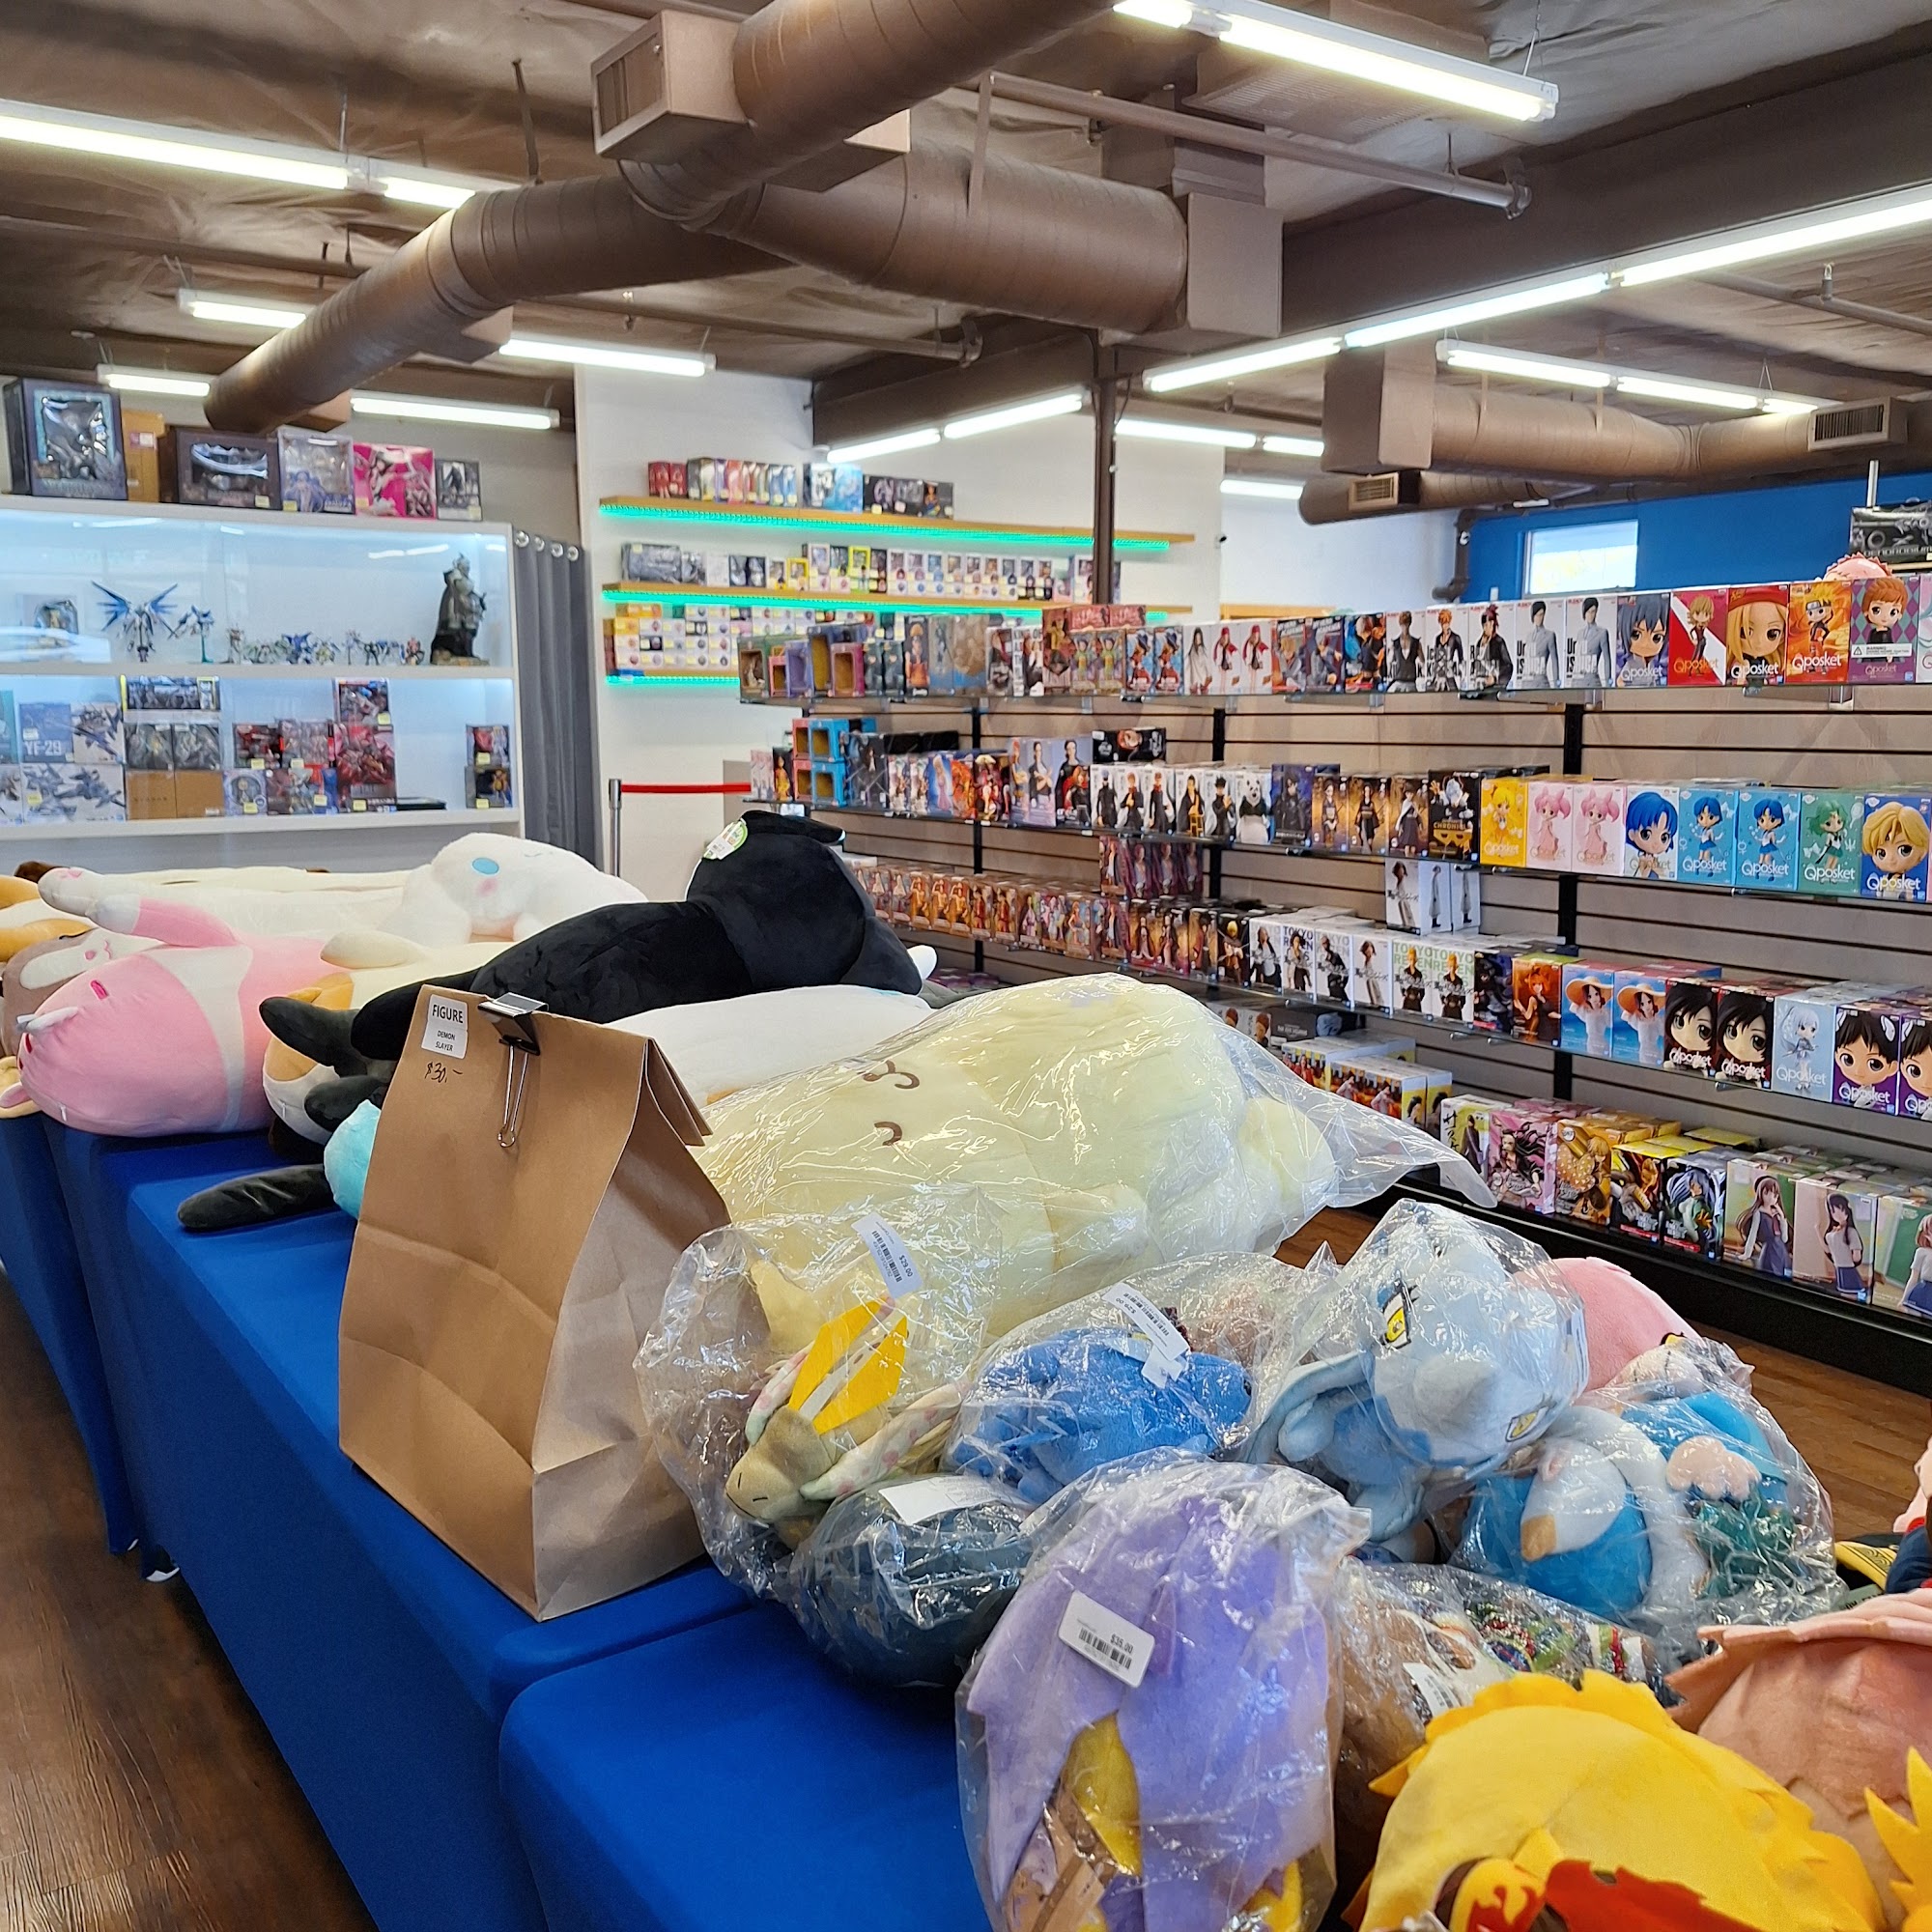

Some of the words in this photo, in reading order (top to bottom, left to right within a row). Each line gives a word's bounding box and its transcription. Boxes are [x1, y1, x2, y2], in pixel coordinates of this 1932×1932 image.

[1730, 659, 1779, 679] Qposket
[1792, 651, 1842, 669] Qposket
[1621, 665, 1663, 682] Qposket
[1864, 664, 1898, 675] Qposket
[1682, 856, 1727, 873] Qposket
[1741, 860, 1790, 877] Qposket
[1804, 864, 1857, 881] Qposket
[1866, 872, 1921, 891] Qposket
[432, 1004, 464, 1024] FIGURE
[437, 1030, 456, 1040] DEMON
[435, 1040, 454, 1052] SLAYER
[1838, 1081, 1891, 1104] Qposket
[898, 1255, 914, 1277] $29.00
[1115, 1297, 1137, 1315] $29.00
[1110, 1634, 1134, 1655] $35.00
